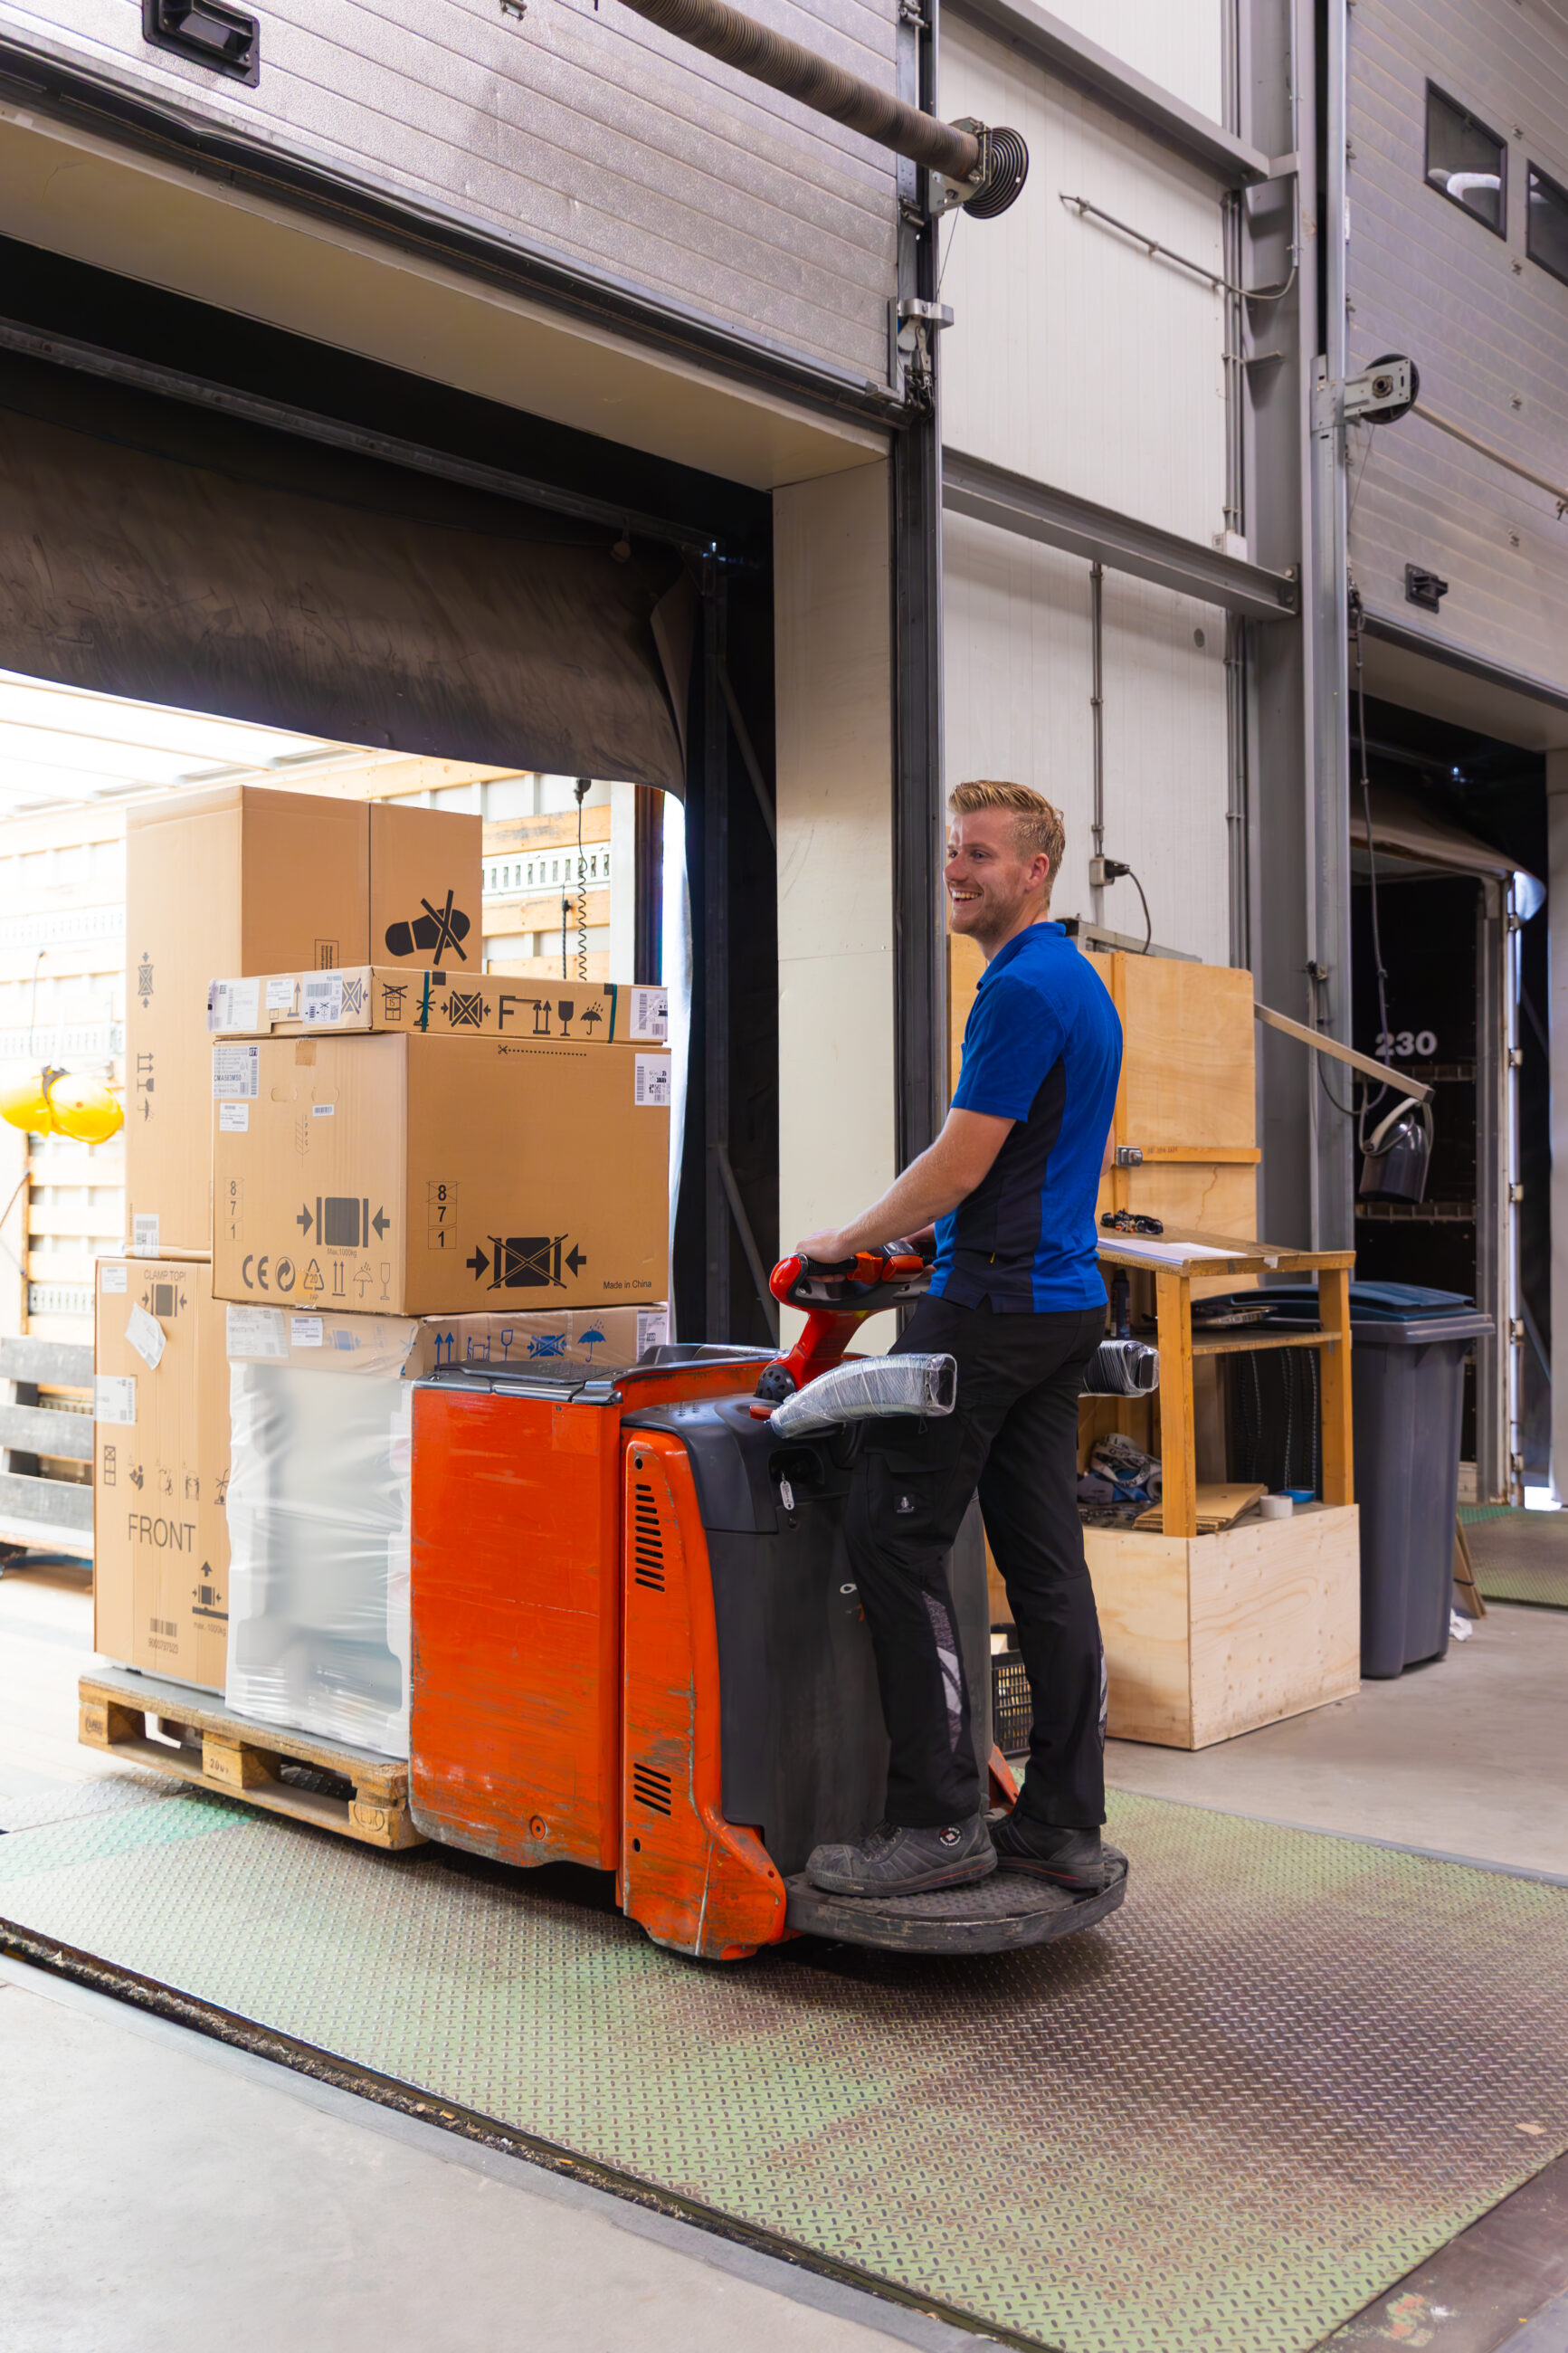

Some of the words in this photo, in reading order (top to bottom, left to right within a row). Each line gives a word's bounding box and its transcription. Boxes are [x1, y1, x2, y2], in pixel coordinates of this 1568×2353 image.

[1375, 1031, 1437, 1056] 230
[230, 1180, 237, 1196] 8
[437, 1184, 447, 1201] 8
[230, 1201, 236, 1216] 7
[437, 1205, 447, 1223] 7
[231, 1224, 235, 1239] 1
[437, 1231, 444, 1247] 1
[603, 1281, 622, 1290] Made
[624, 1281, 631, 1289] in
[632, 1280, 651, 1289] China
[128, 1513, 195, 1553] FRONT
